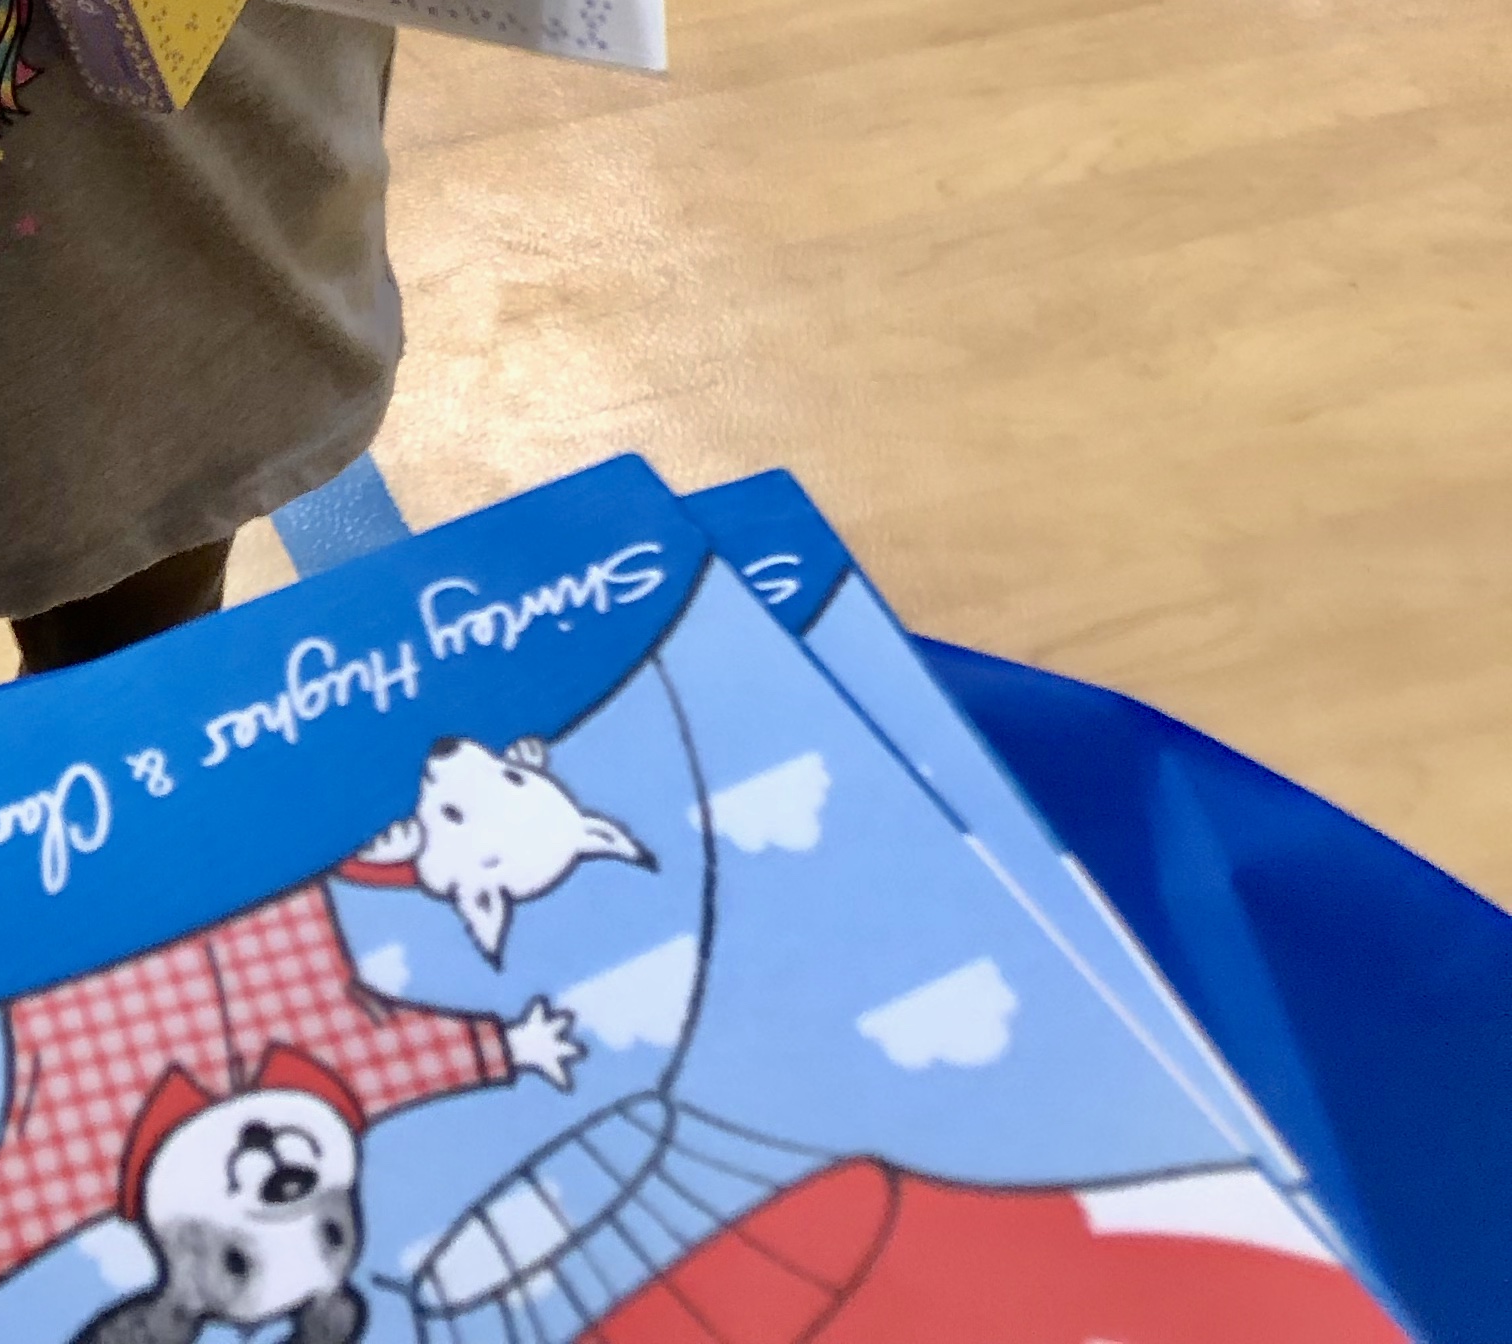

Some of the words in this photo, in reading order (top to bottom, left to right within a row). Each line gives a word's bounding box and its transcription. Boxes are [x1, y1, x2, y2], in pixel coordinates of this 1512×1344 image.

[419, 541, 664, 660] Shirley
[201, 637, 421, 768] Hughes
[124, 746, 176, 799] &
